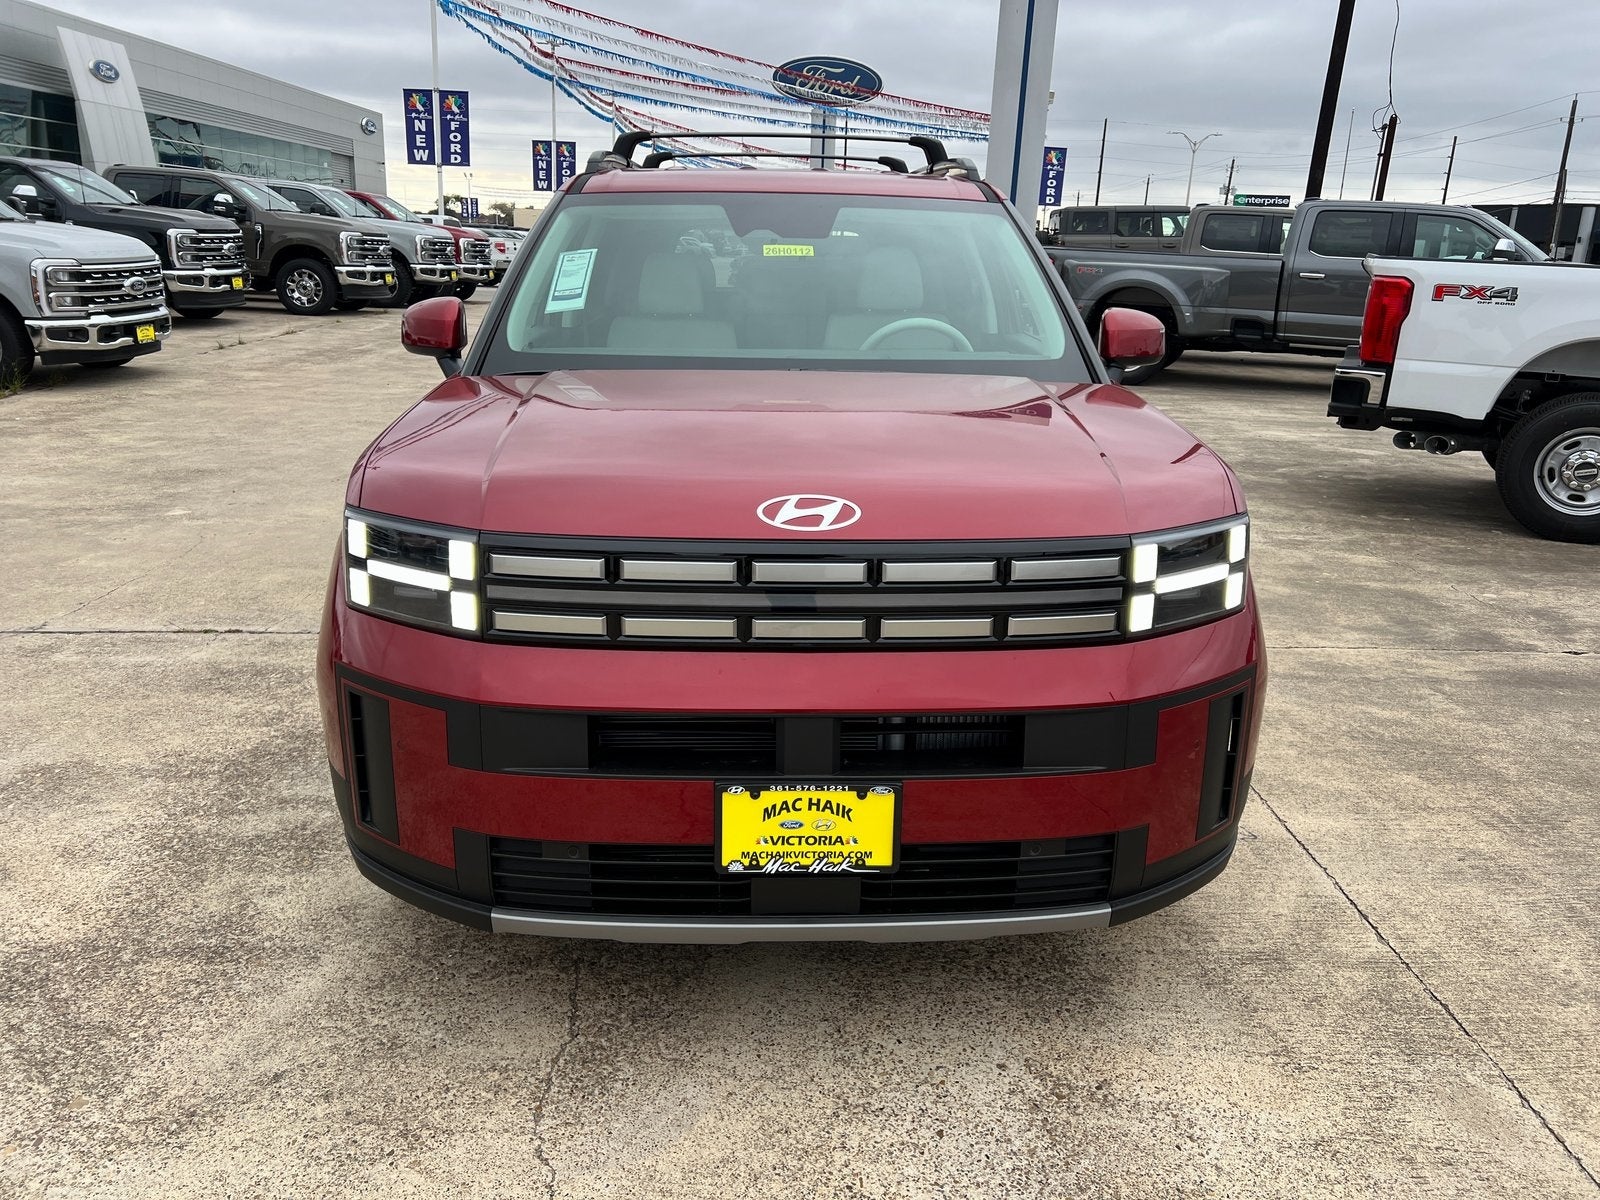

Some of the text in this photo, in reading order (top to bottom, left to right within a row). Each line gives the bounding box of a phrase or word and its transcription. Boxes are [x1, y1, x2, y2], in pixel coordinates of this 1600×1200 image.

[796, 64, 861, 95] Ford
[413, 119, 429, 162] NEW
[449, 121, 462, 164] FORD
[537, 160, 548, 189] NEW
[561, 161, 571, 183] FOR
[1045, 170, 1057, 204] FORD
[1235, 196, 1289, 206] enterprise
[765, 247, 812, 255] 26H0112
[1431, 283, 1518, 302] FX4
[769, 784, 850, 792] 361-576-1221
[762, 797, 853, 823] MAC HAIK
[770, 835, 845, 846] VICTORIA
[740, 850, 873, 860] MACHAIKVICTORIA.COM
[760, 857, 857, 874] Mac Haik
